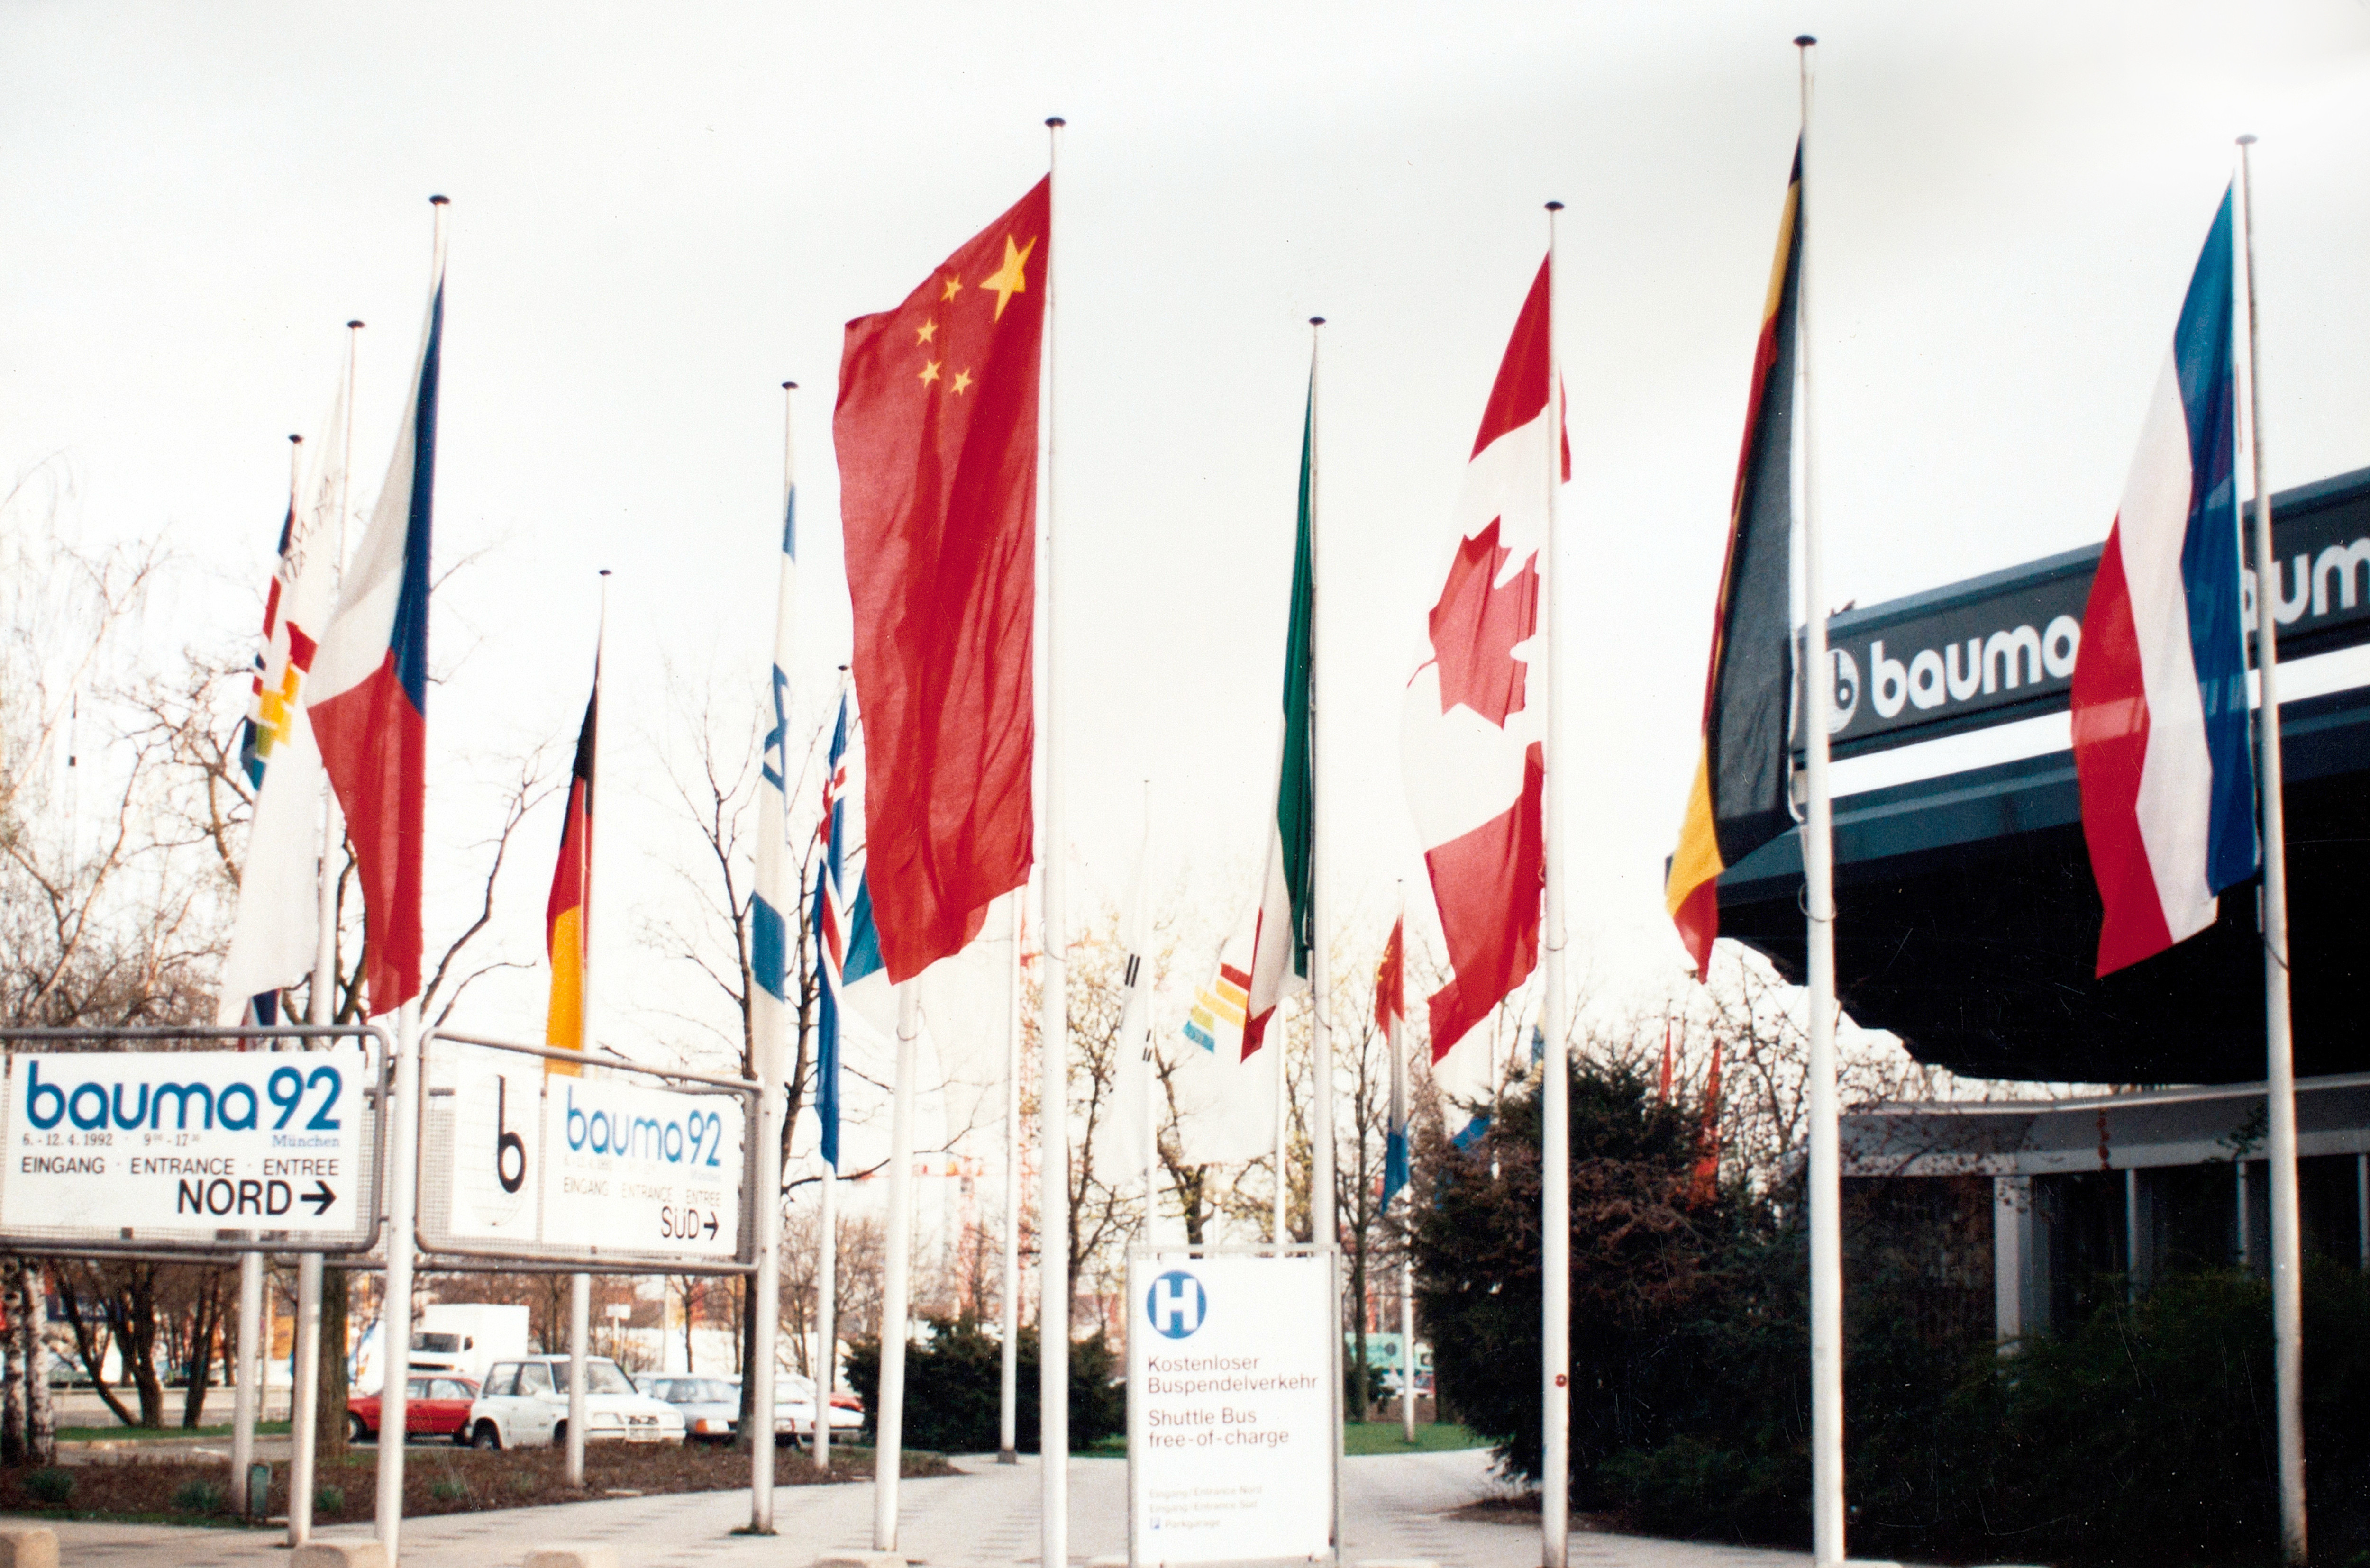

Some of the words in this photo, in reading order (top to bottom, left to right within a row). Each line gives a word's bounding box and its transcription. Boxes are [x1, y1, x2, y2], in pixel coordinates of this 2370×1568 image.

[1870, 615, 2082, 718] bauma
[27, 1060, 258, 1130] bauma
[267, 1065, 342, 1131] 92
[498, 1074, 526, 1193] b
[567, 1084, 683, 1163] bauma
[688, 1110, 721, 1167] 92
[83, 1133, 113, 1146] 1992
[272, 1134, 340, 1147] München
[22, 1157, 105, 1174] EINGANG
[131, 1158, 235, 1175] ENTRANCE
[264, 1159, 339, 1176] ENTREE
[178, 1178, 292, 1215] NORD
[564, 1177, 609, 1197] EINGANG
[622, 1183, 673, 1202] ENTRANCE
[686, 1189, 721, 1207] ENTREE
[1156, 1279, 1198, 1329] H
[1148, 1355, 1260, 1372] Kostenloser
[1148, 1374, 1319, 1396] Buspendelverkehr
[1149, 1409, 1214, 1427] Shuttle
[1222, 1408, 1257, 1424] Bus
[1149, 1429, 1289, 1448] free-of-charge
